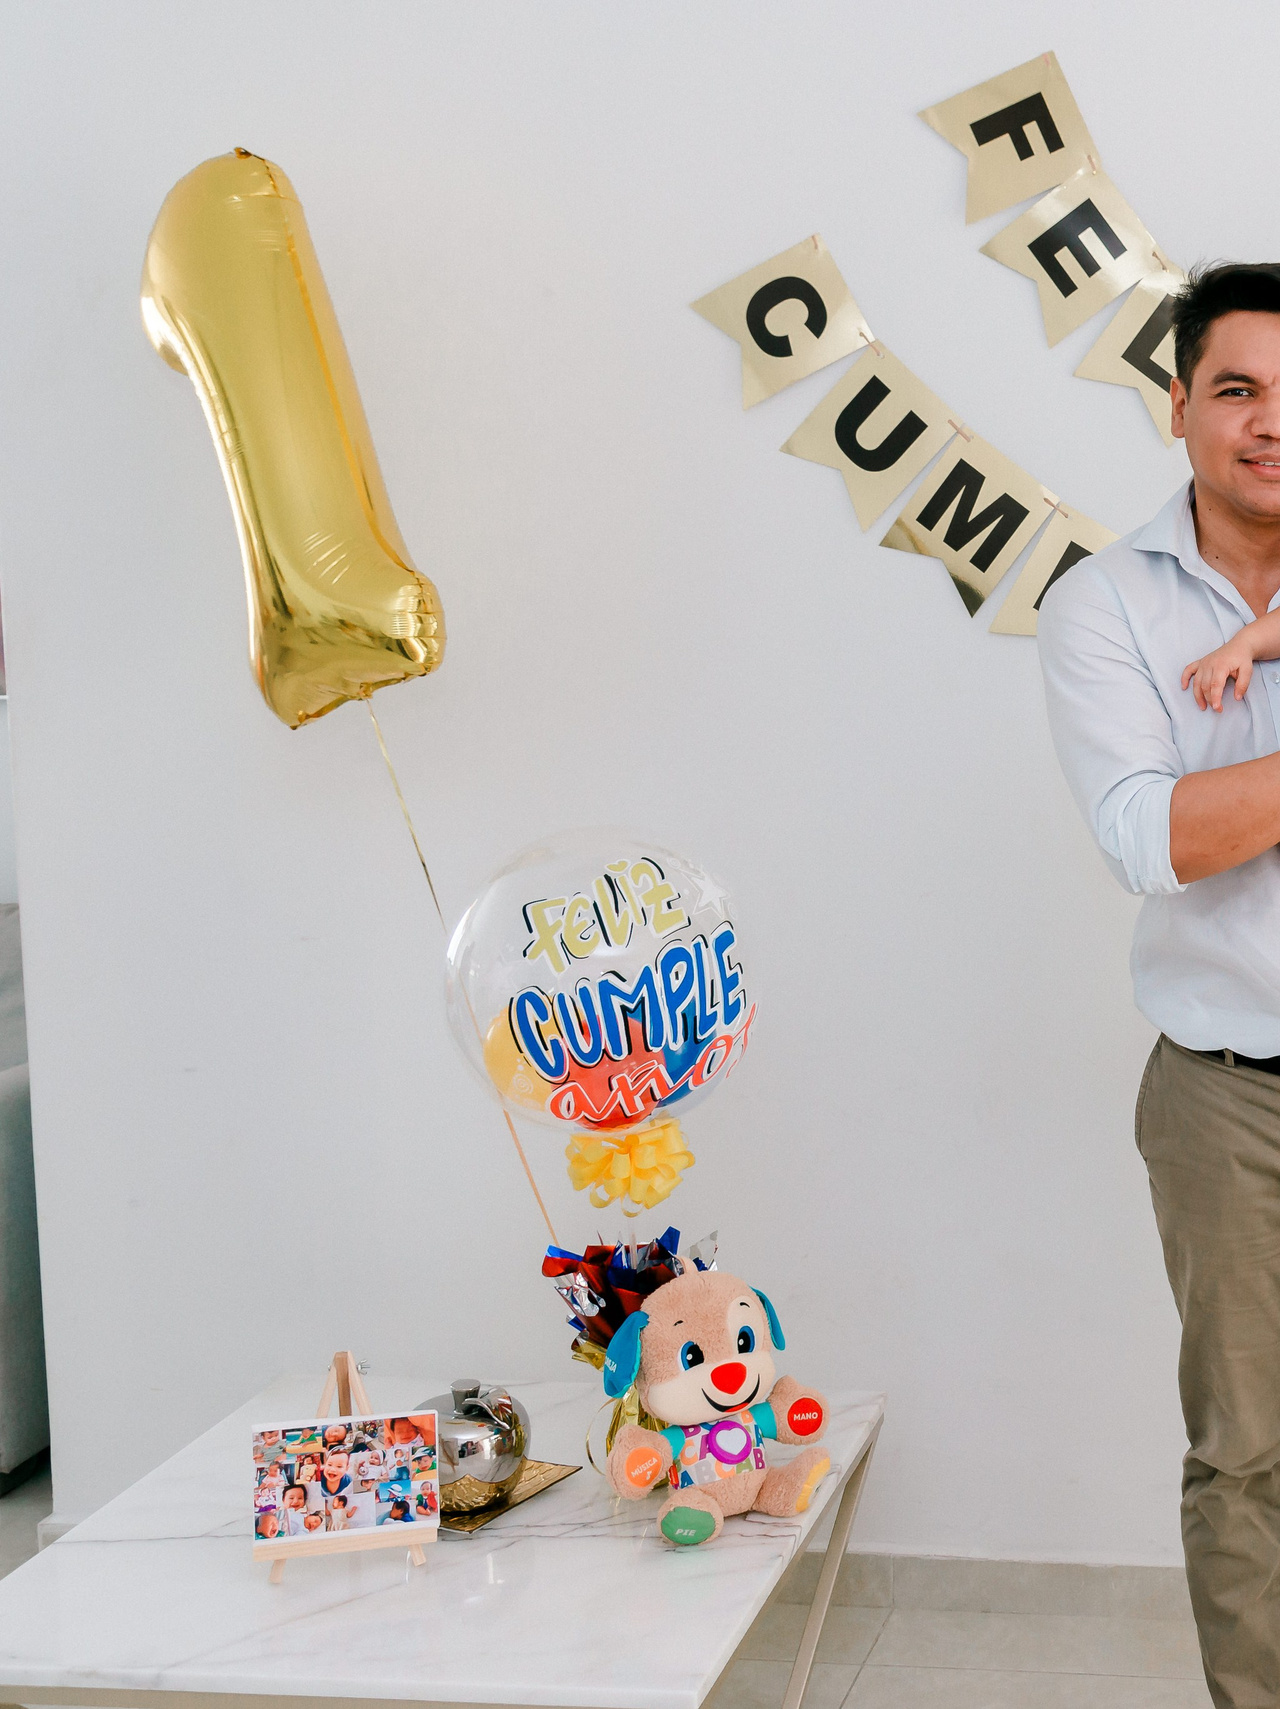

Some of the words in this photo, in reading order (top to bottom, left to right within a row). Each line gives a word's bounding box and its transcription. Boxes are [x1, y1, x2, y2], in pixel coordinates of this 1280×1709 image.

[523, 857, 691, 974] FELIZ
[508, 920, 747, 1084] CUMPLE
[793, 1411, 818, 1421] MANO
[630, 1456, 659, 1478] MÚSICA
[675, 1527, 696, 1537] PIE
